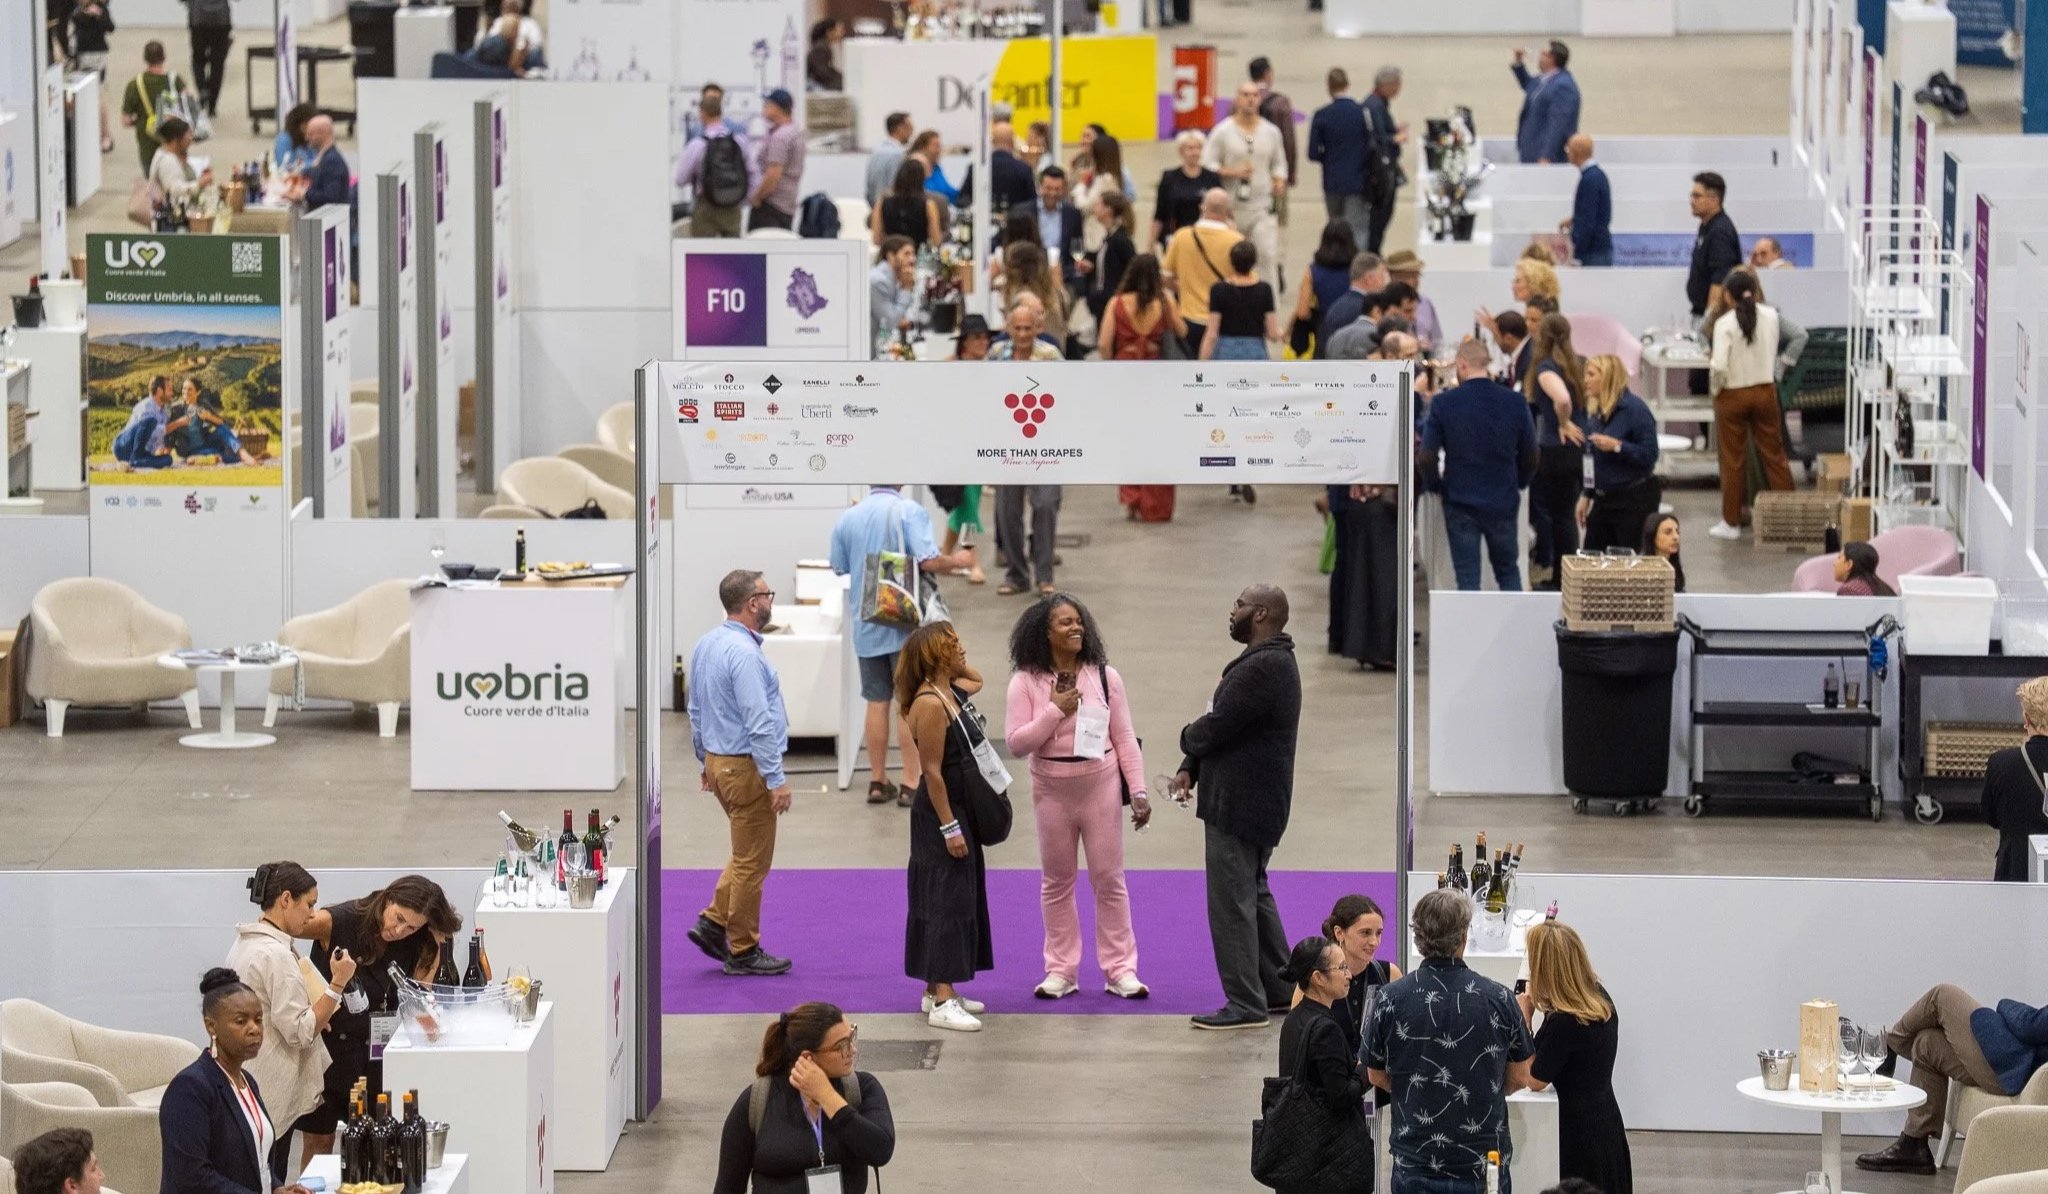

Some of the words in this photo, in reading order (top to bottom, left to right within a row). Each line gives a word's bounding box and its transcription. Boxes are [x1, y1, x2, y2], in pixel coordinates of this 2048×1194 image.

[105, 290, 151, 301] Discover
[154, 290, 195, 303] Umbria,
[197, 291, 207, 302] in
[209, 292, 221, 303] all
[224, 294, 263, 303] senses.
[707, 288, 746, 313] F10
[801, 408, 832, 418] Uberti
[826, 434, 854, 445] gorgo
[977, 448, 1007, 458] MORE
[1010, 448, 1038, 458] THAN
[1040, 448, 1083, 458] GRAPES
[1025, 457, 1061, 471] Imports
[774, 492, 794, 501] USA
[436, 663, 589, 700] umbria
[464, 705, 503, 717] Cuore
[506, 705, 543, 717] verde
[546, 705, 590, 717] d'Italia
